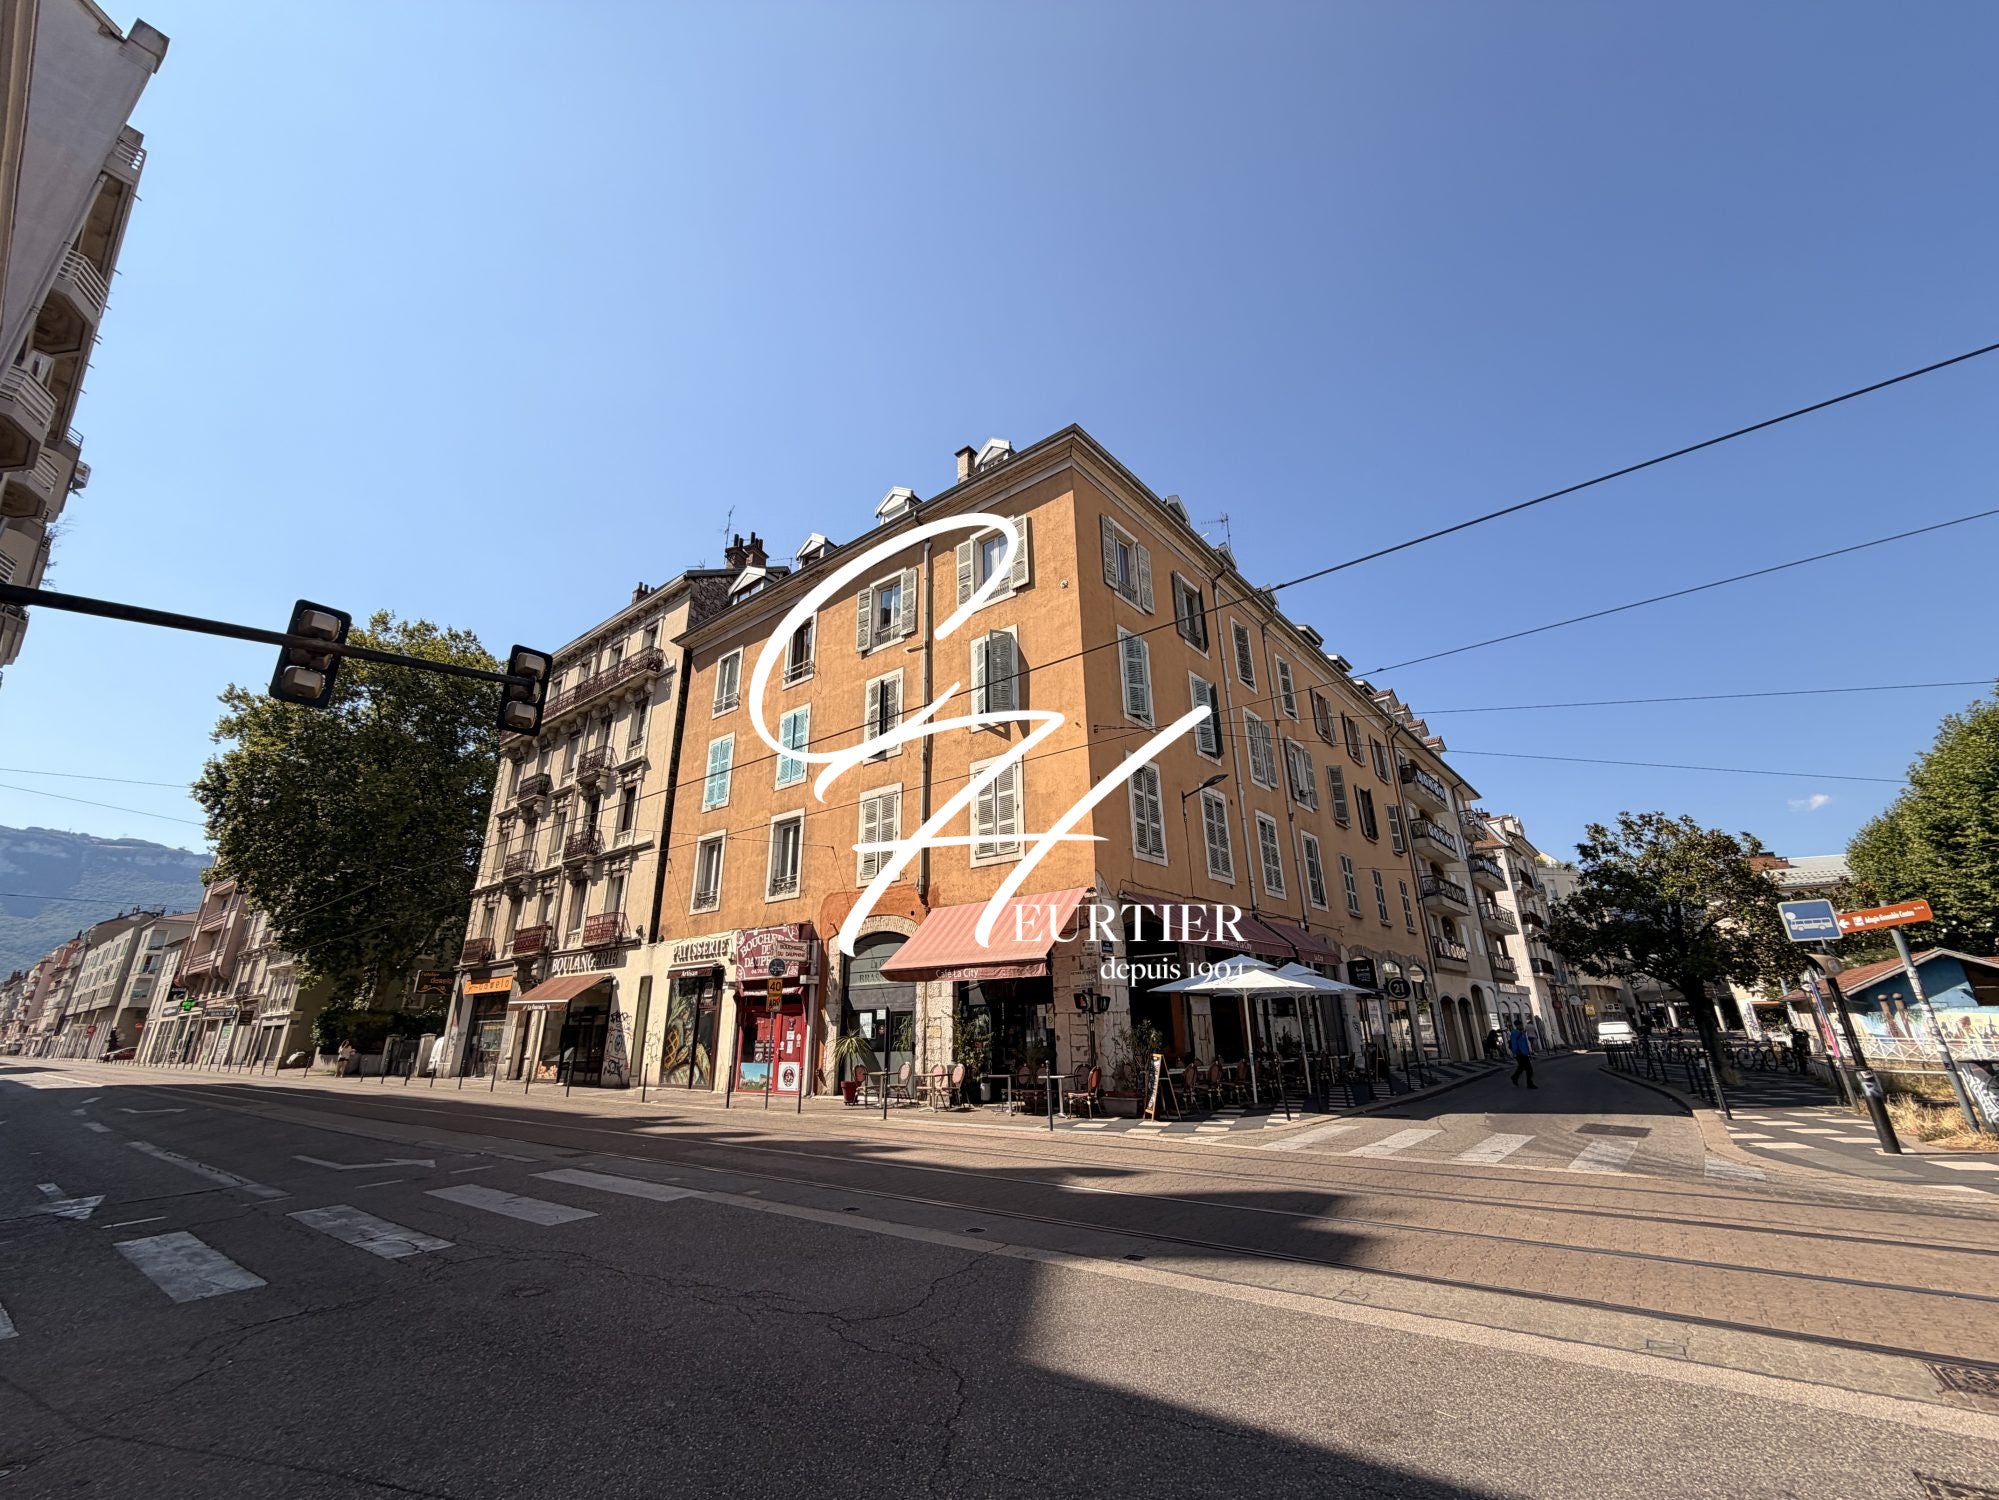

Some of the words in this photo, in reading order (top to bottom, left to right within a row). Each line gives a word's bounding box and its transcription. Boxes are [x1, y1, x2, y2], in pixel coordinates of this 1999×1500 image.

[552, 949, 620, 973] BOULANGERIE
[681, 969, 698, 977] Artisan
[935, 969, 953, 979] Café
[953, 968, 962, 978] La
[963, 967, 979, 979] City
[770, 981, 781, 991] 40
[1393, 983, 1405, 993] 21
